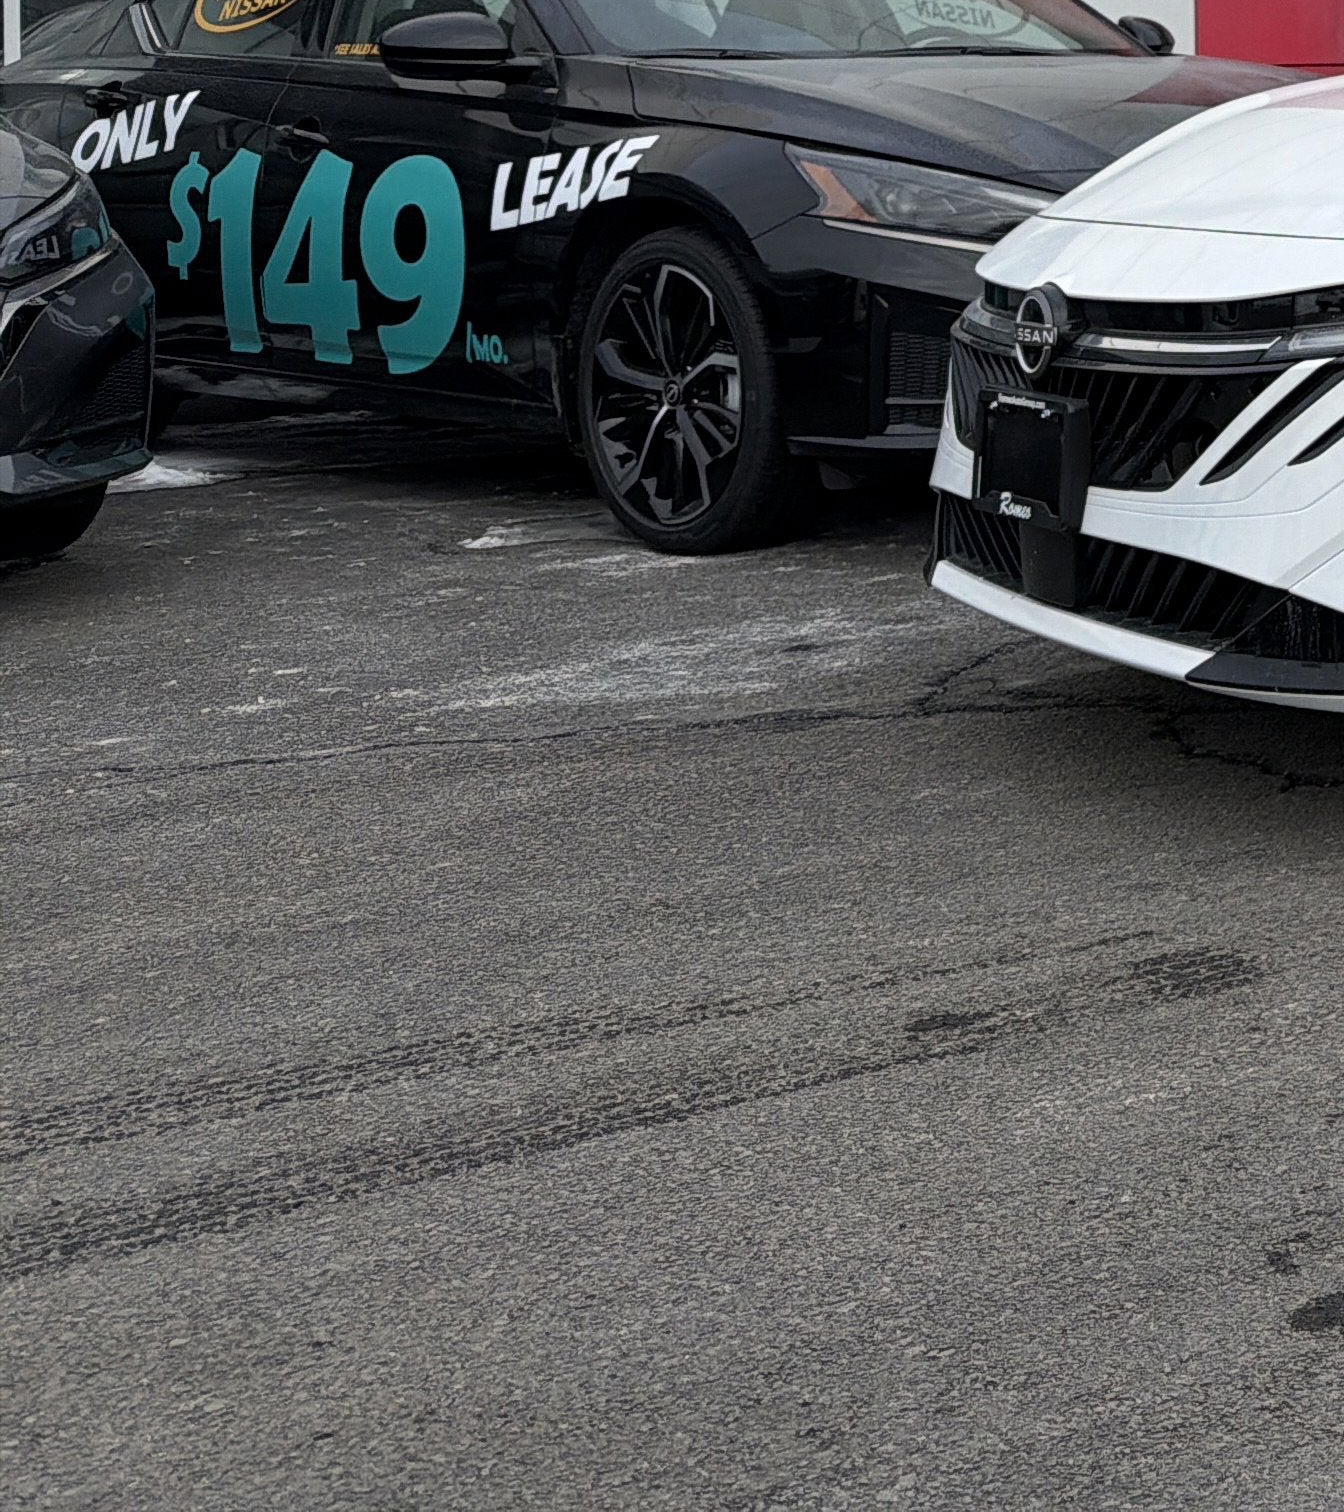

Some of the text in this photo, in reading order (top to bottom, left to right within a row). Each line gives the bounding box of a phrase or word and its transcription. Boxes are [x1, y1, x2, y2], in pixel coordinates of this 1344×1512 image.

[71, 90, 200, 173] ONLY
[490, 135, 661, 232] LEASE
[166, 148, 465, 375] $149
